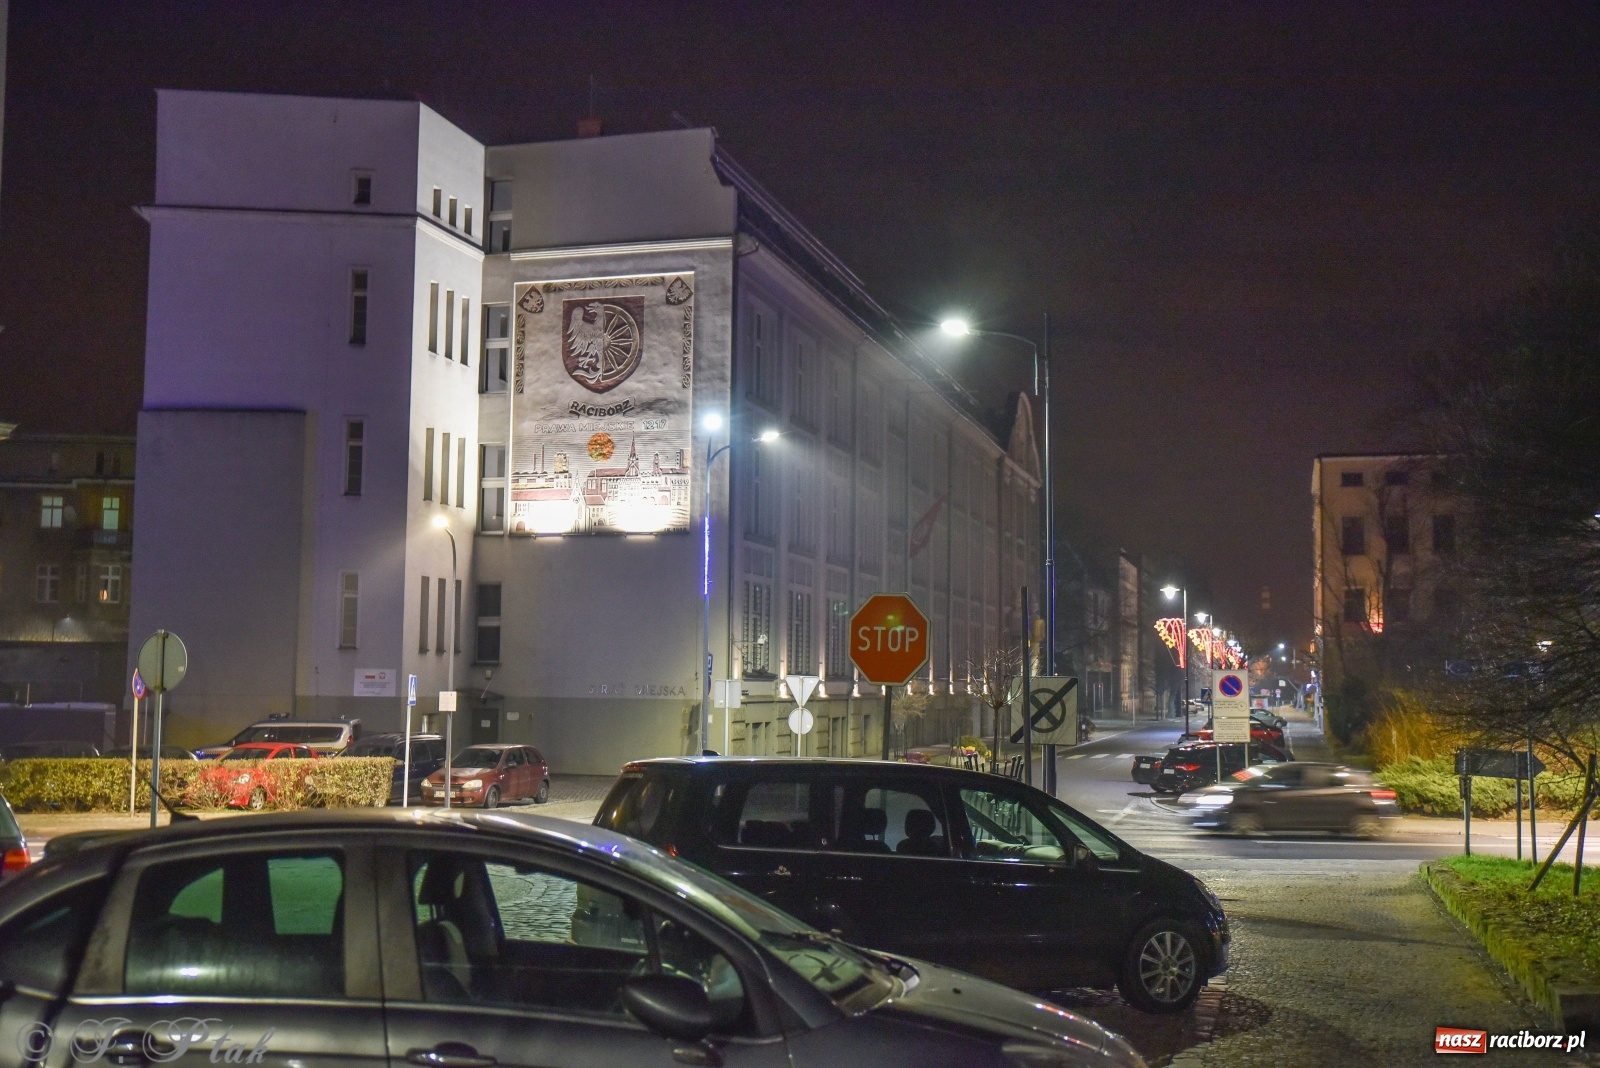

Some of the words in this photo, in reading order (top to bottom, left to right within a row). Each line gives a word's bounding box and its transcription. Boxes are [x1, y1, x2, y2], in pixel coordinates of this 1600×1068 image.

[534, 423, 576, 433] PRAWA
[643, 419, 667, 430] 1217
[858, 626, 919, 653] STOP
